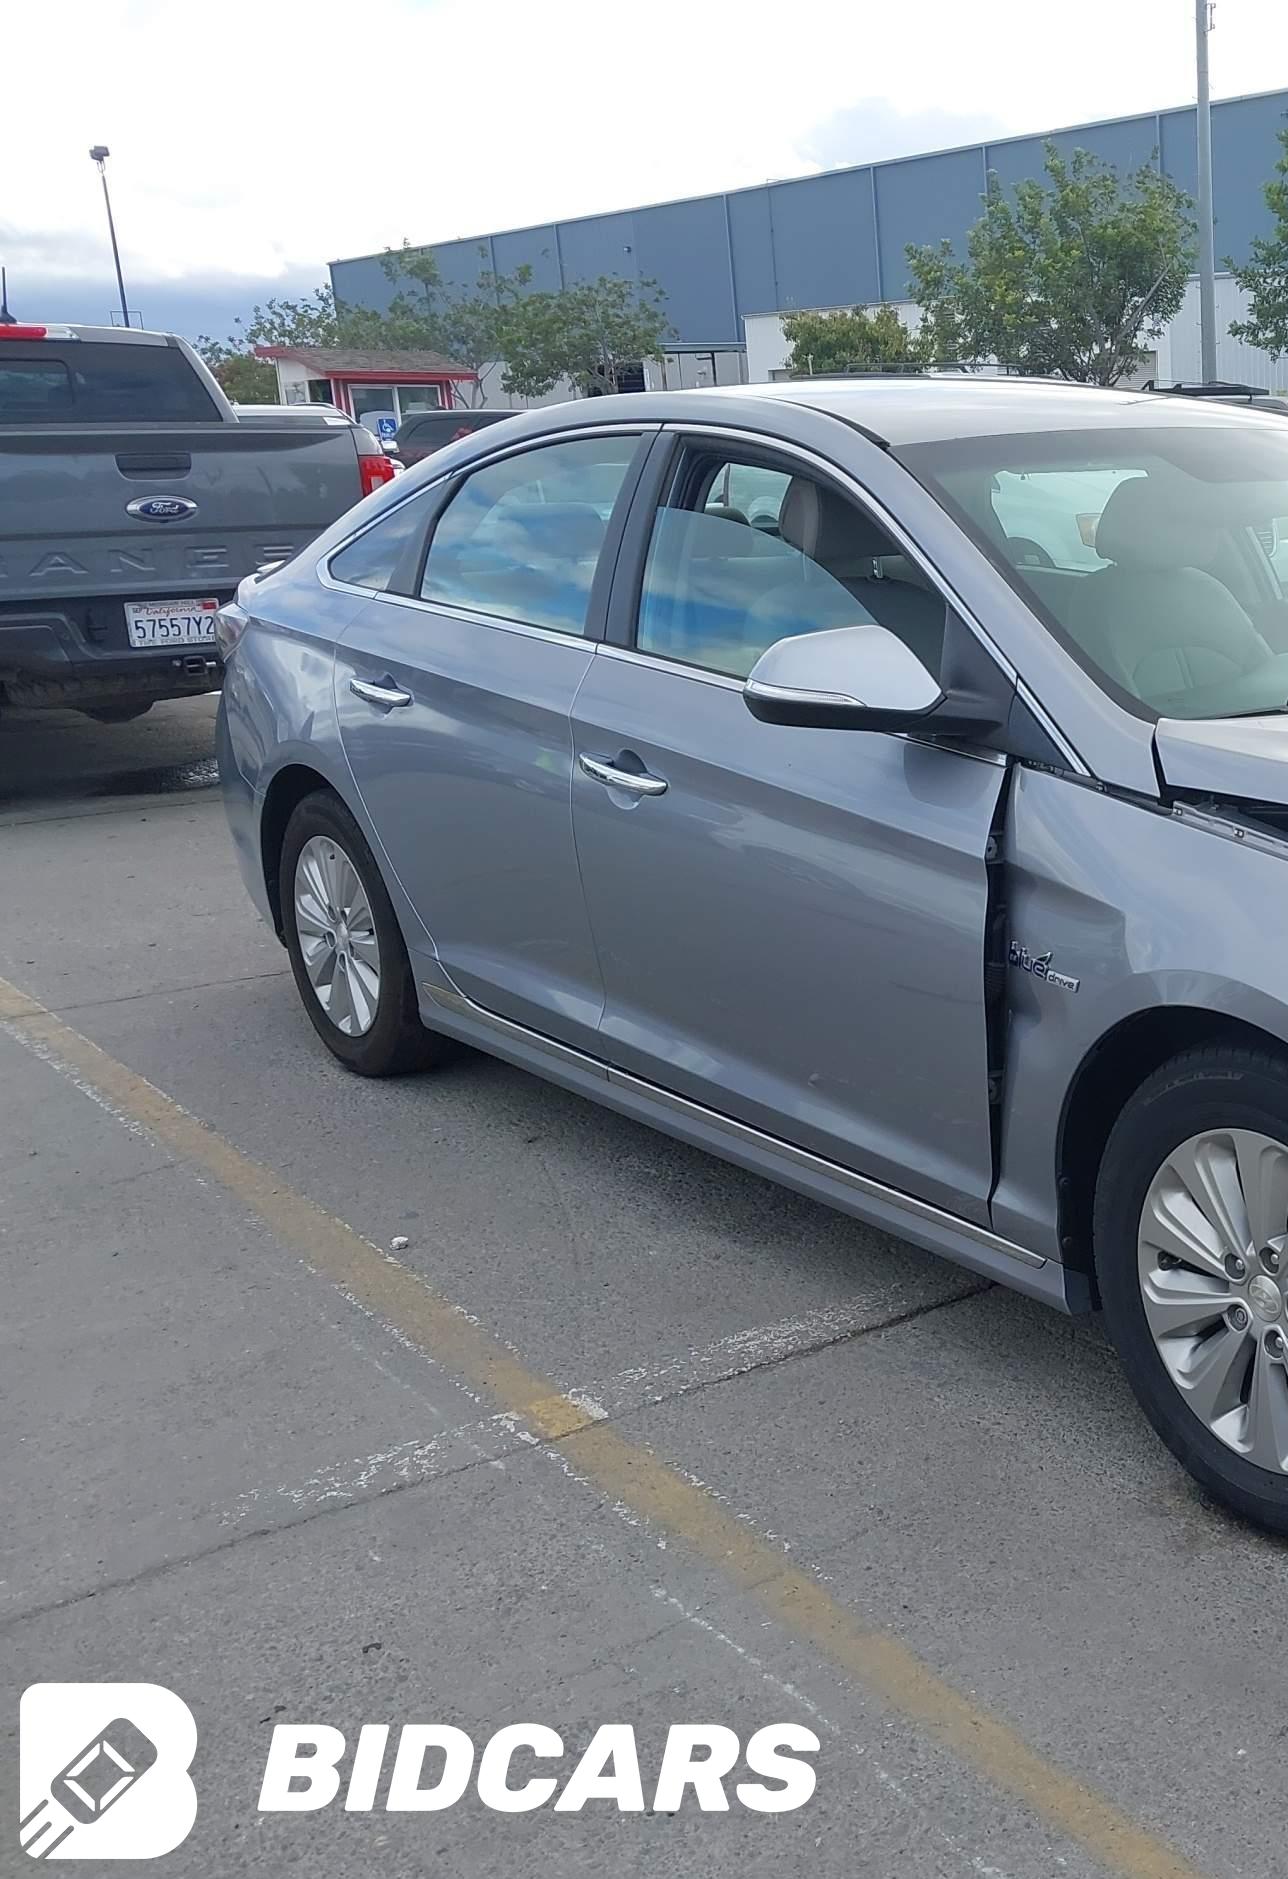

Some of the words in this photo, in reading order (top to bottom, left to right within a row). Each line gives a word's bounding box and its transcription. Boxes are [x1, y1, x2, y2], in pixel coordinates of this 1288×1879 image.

[150, 502, 180, 514] Ford
[0, 544, 295, 578] ANGE
[145, 606, 203, 618] California
[134, 616, 214, 639] 57557Y2
[1048, 972, 1076, 991] drive
